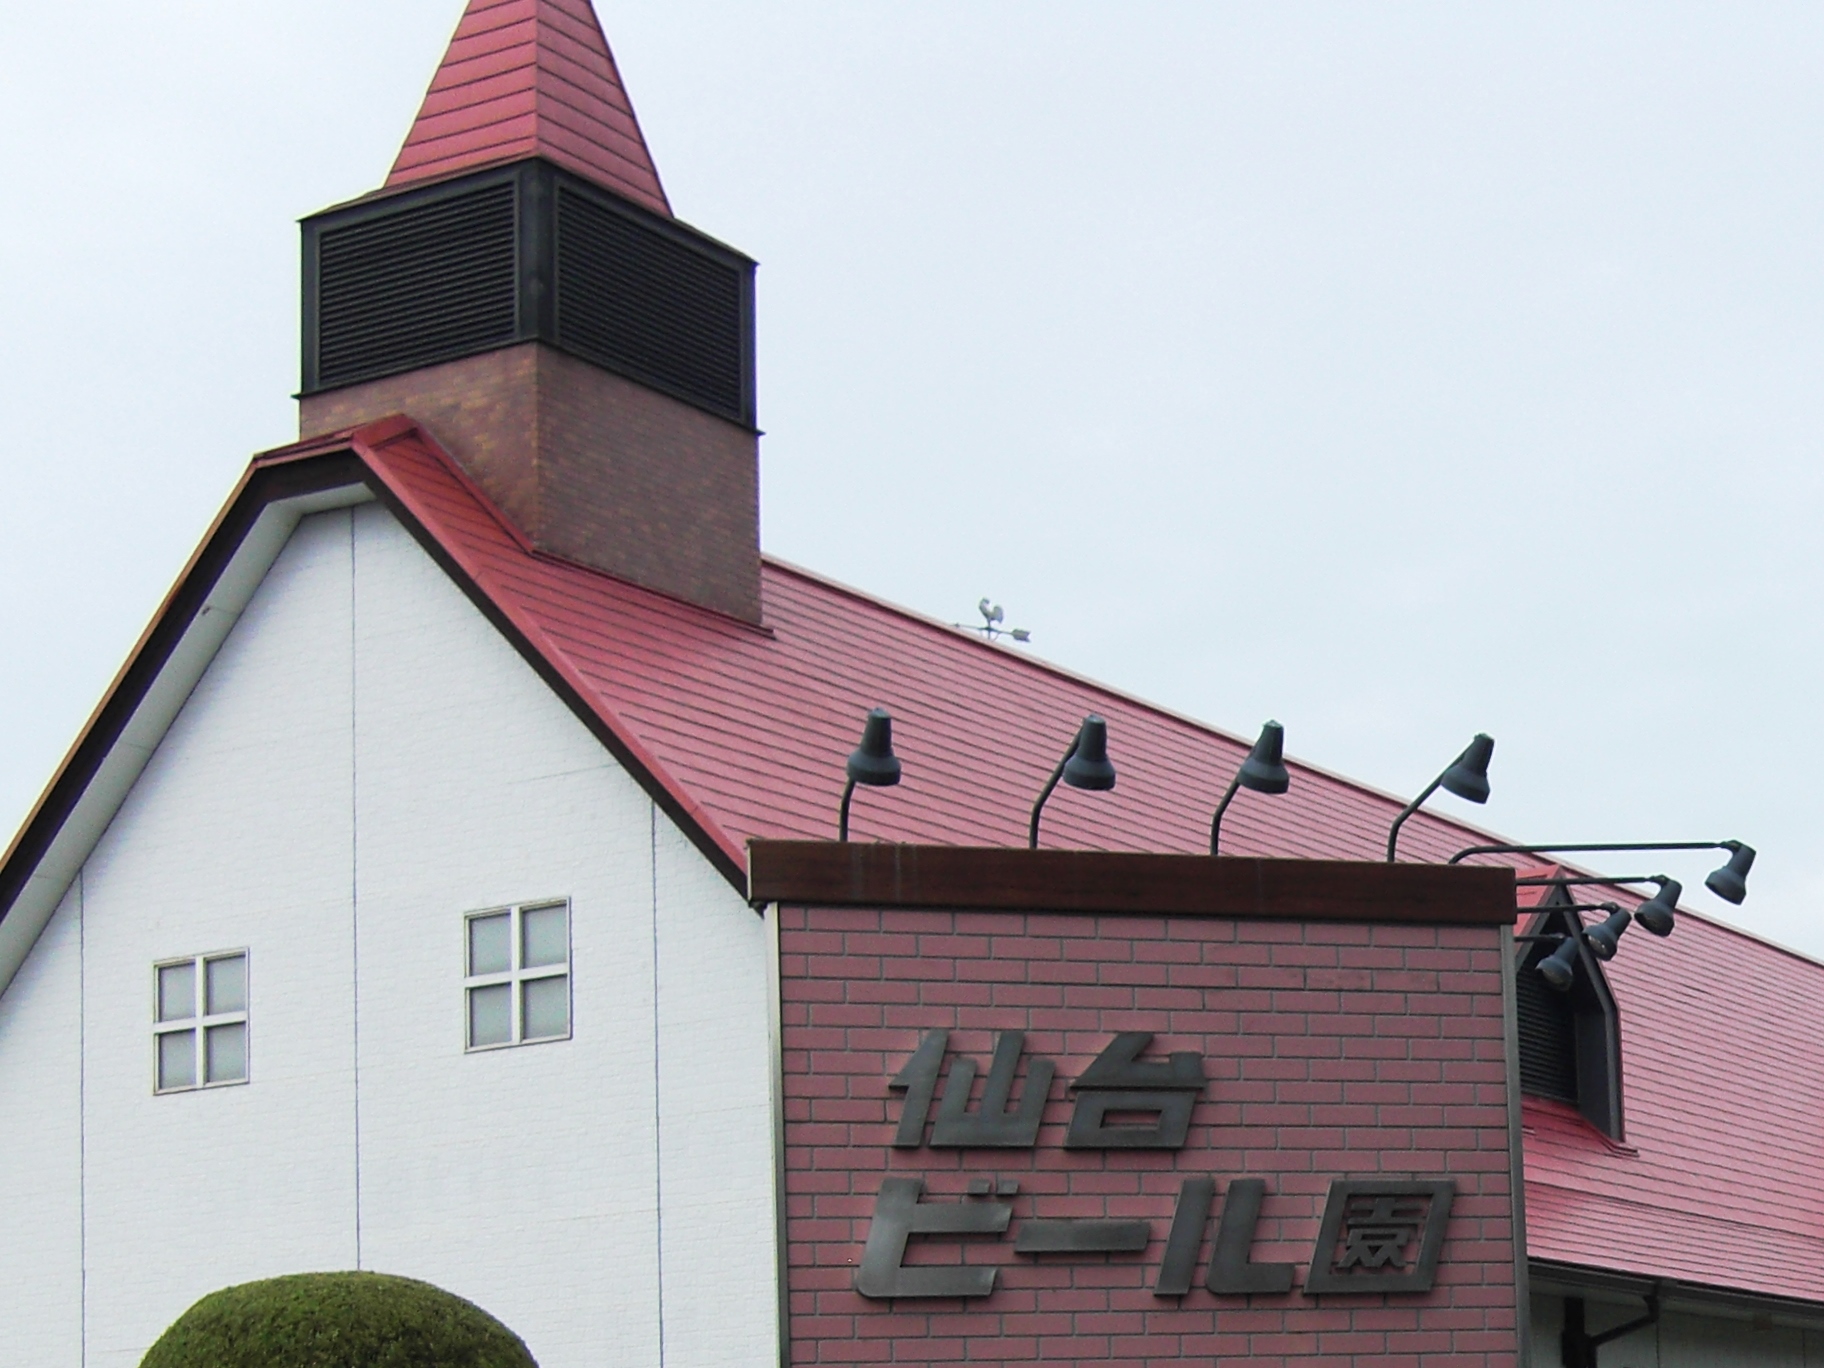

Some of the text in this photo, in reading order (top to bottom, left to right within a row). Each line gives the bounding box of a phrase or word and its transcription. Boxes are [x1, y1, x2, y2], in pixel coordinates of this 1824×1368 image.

[888, 1028, 1206, 1150] 仙台
[856, 1175, 1457, 1299] ビール園
